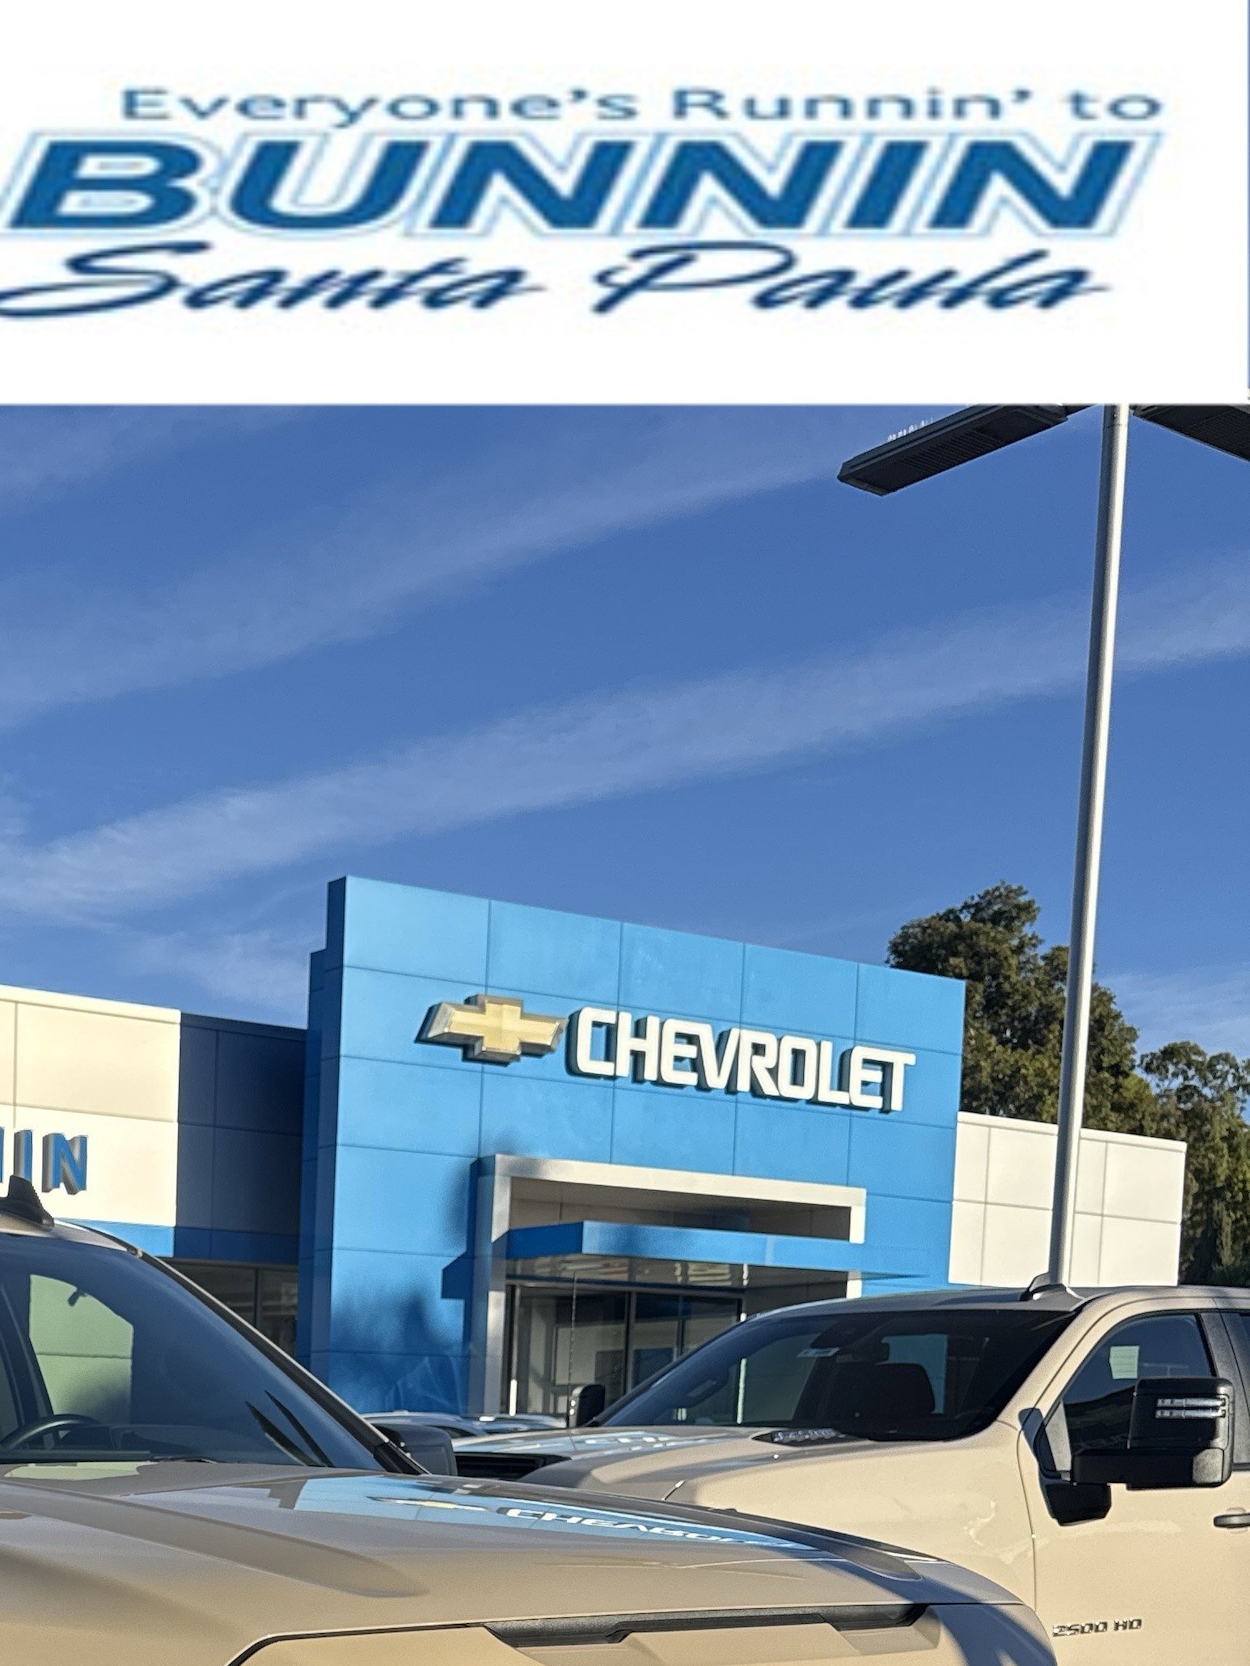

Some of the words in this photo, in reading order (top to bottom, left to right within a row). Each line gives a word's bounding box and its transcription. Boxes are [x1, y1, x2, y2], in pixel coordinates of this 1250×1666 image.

[566, 1006, 917, 1113] CHEVROLET
[1052, 1621, 1109, 1638] 2500
[1113, 1618, 1143, 1632] HD
